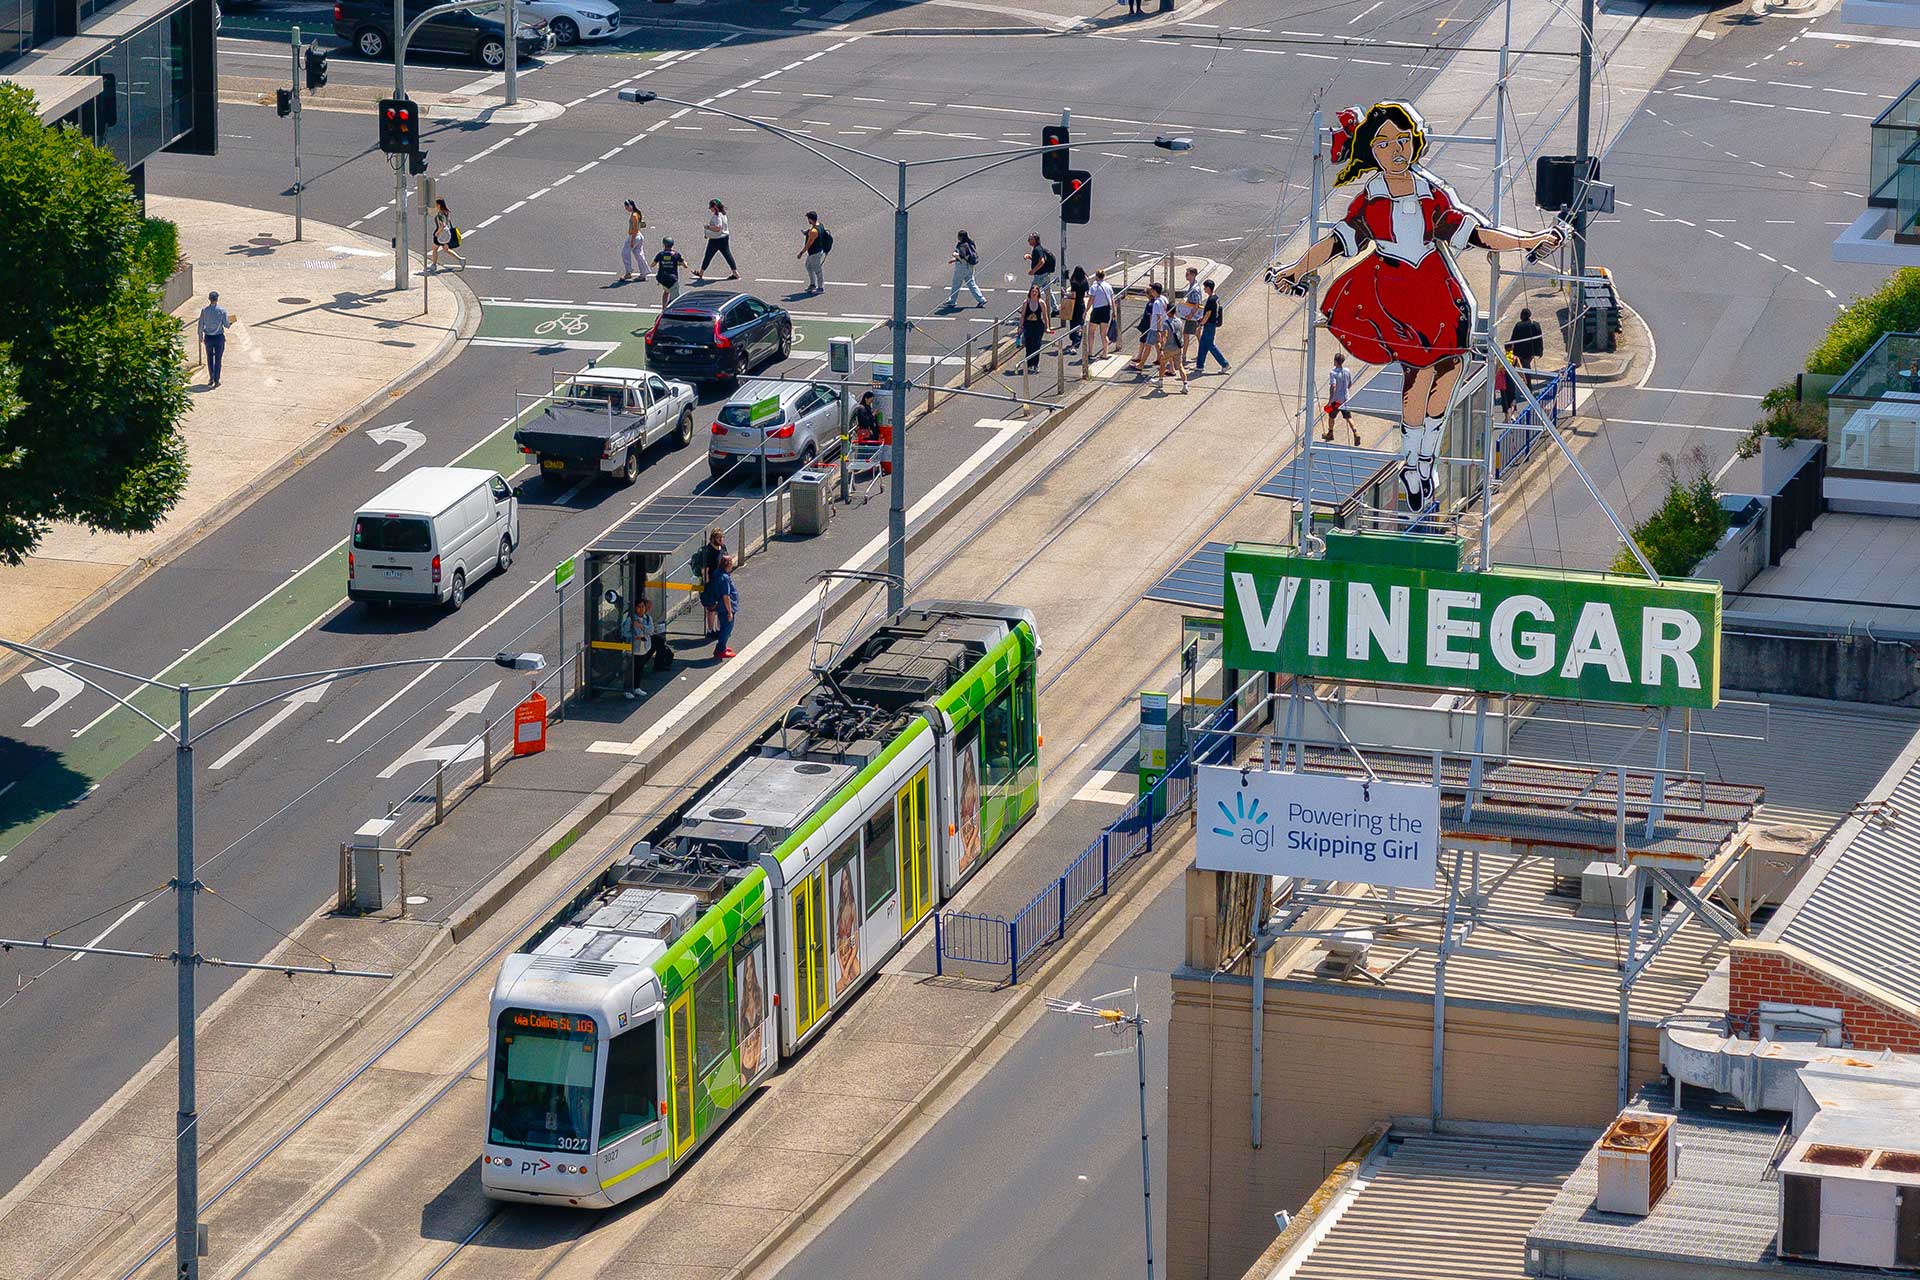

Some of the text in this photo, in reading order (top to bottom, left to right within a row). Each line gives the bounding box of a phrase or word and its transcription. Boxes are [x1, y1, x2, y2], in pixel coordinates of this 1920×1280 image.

[1231, 571, 1702, 689] VINEGAR
[1288, 802, 1423, 836] Powering the
[1239, 824, 1275, 852] agl
[1287, 831, 1419, 862] Skipping Girl
[514, 1014, 594, 1034] via Collins St 109
[557, 1137, 588, 1150] 3027
[603, 1150, 619, 1163] 3027
